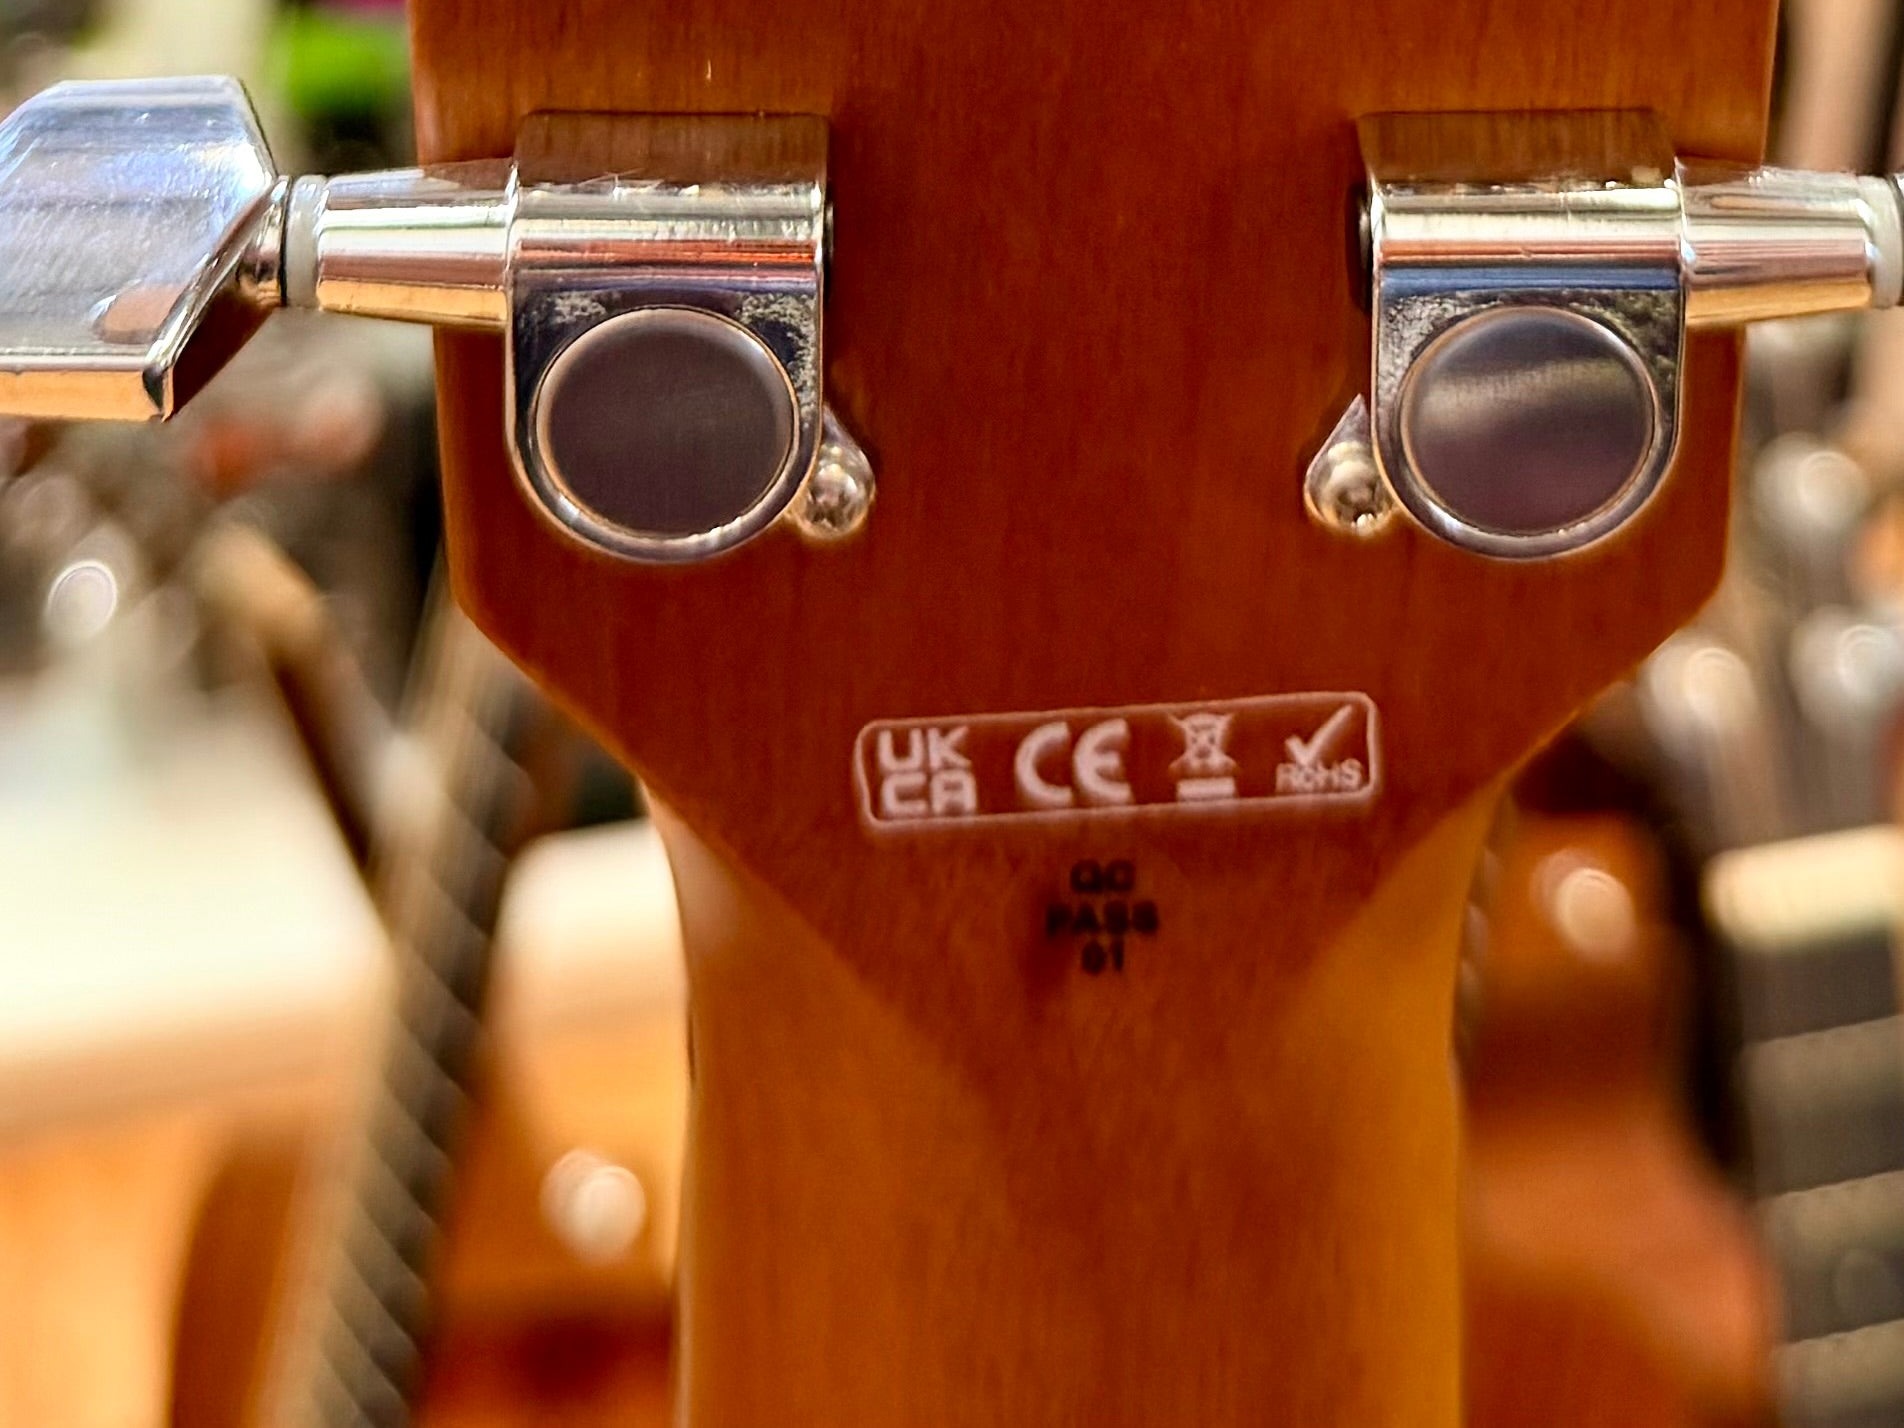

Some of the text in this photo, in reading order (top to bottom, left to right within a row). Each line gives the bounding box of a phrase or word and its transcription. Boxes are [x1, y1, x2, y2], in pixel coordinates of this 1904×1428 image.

[876, 724, 972, 772] UK
[1013, 717, 1134, 810] CE
[879, 770, 978, 819] CA
